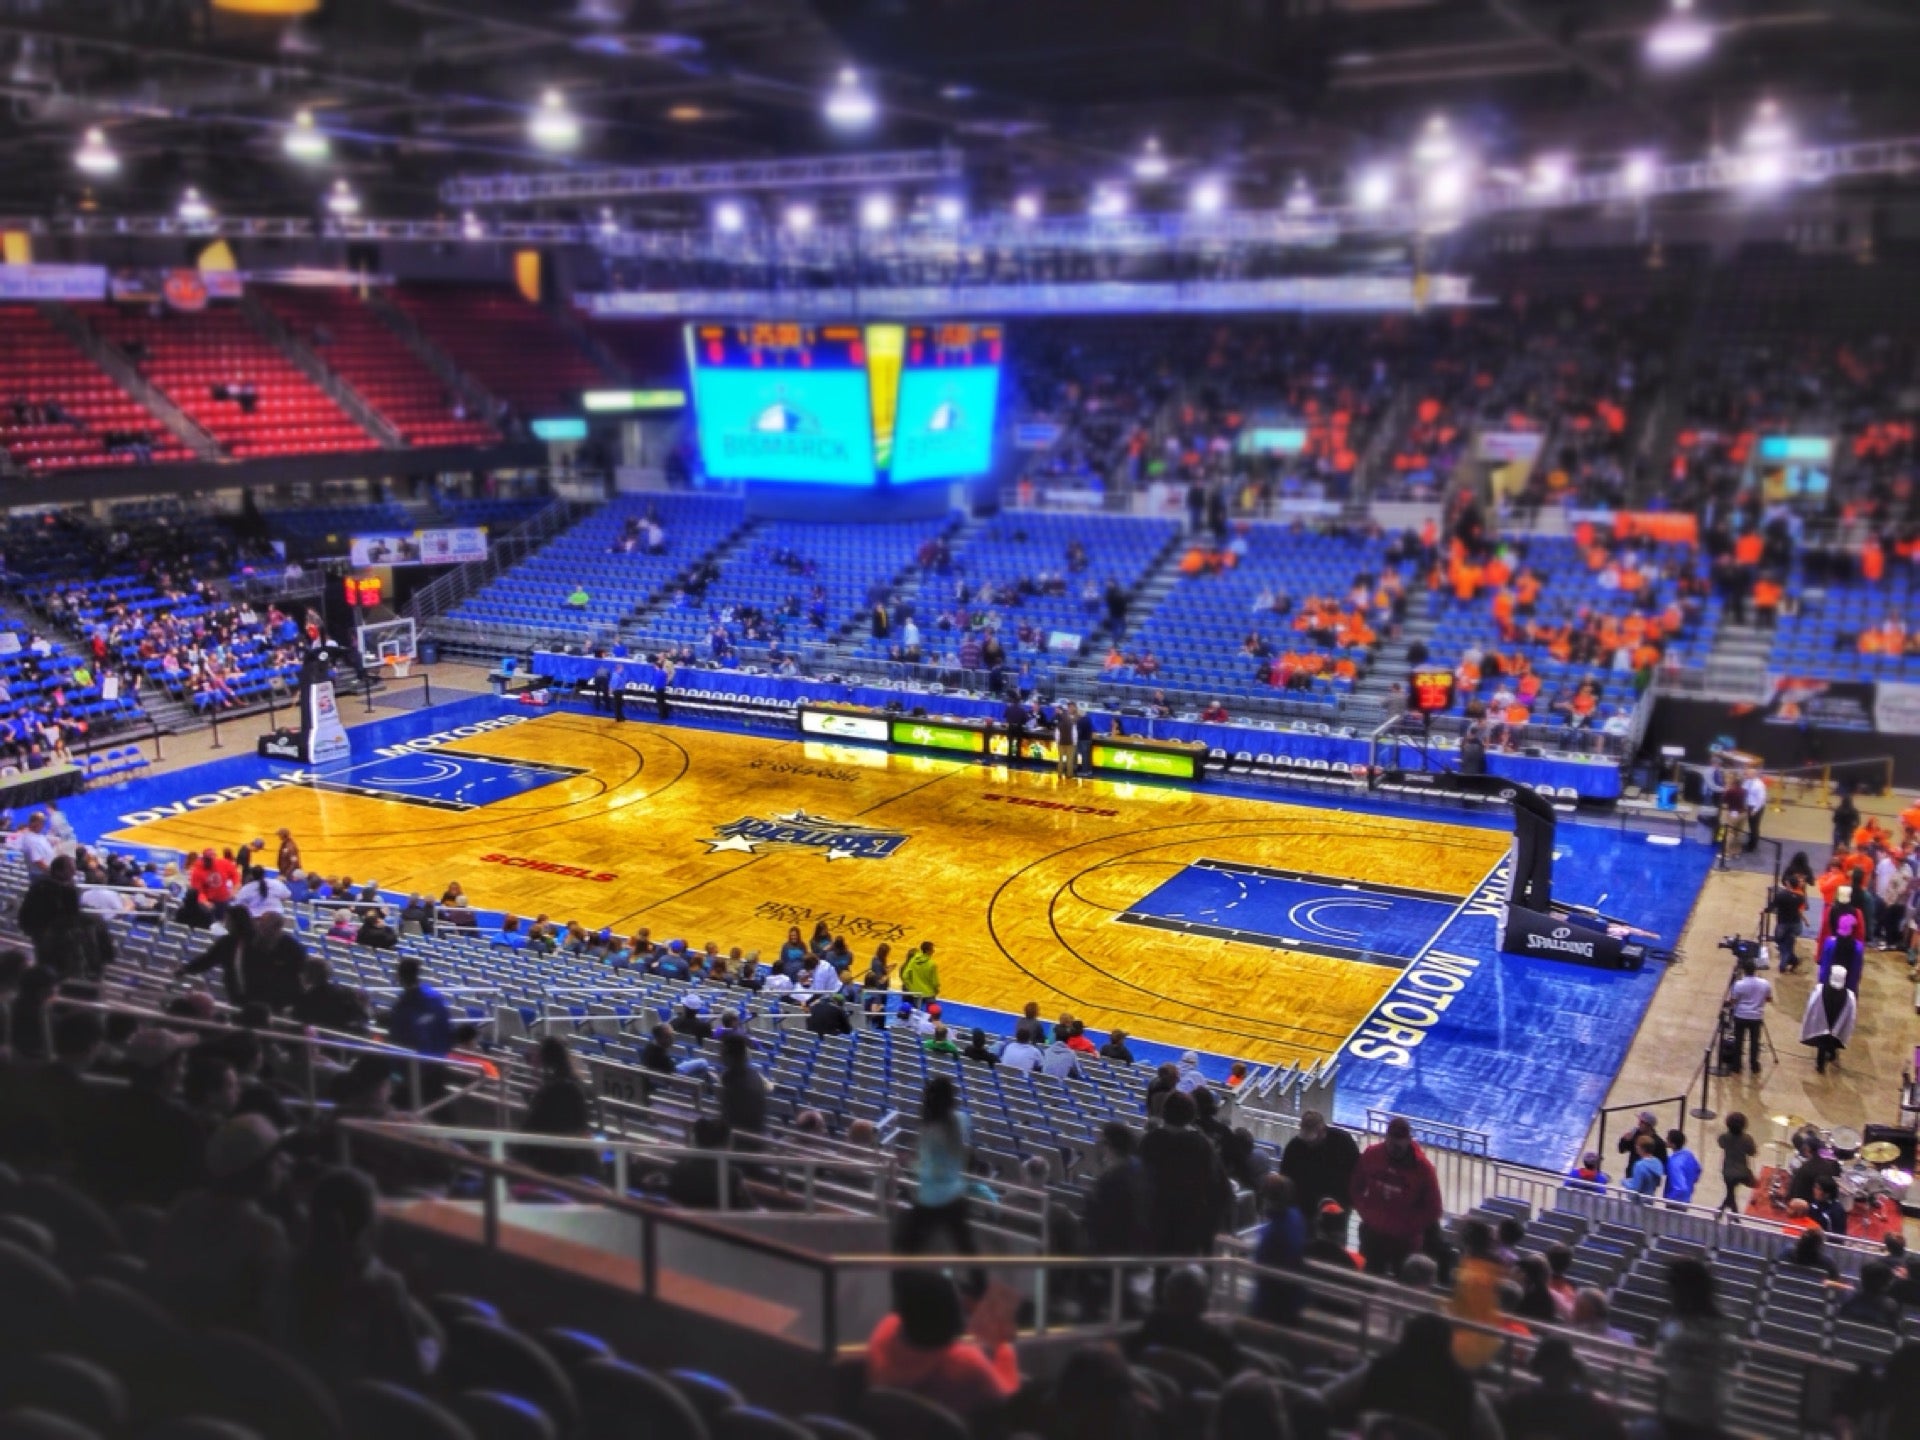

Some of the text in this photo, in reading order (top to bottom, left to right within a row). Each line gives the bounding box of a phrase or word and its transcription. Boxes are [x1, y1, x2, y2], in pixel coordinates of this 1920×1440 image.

[117, 714, 529, 826] DVORAK MOTORS
[479, 853, 619, 882] SCHEELS
[1527, 934, 1594, 957] SPALDING
[1349, 949, 1481, 1069] MOTORS
